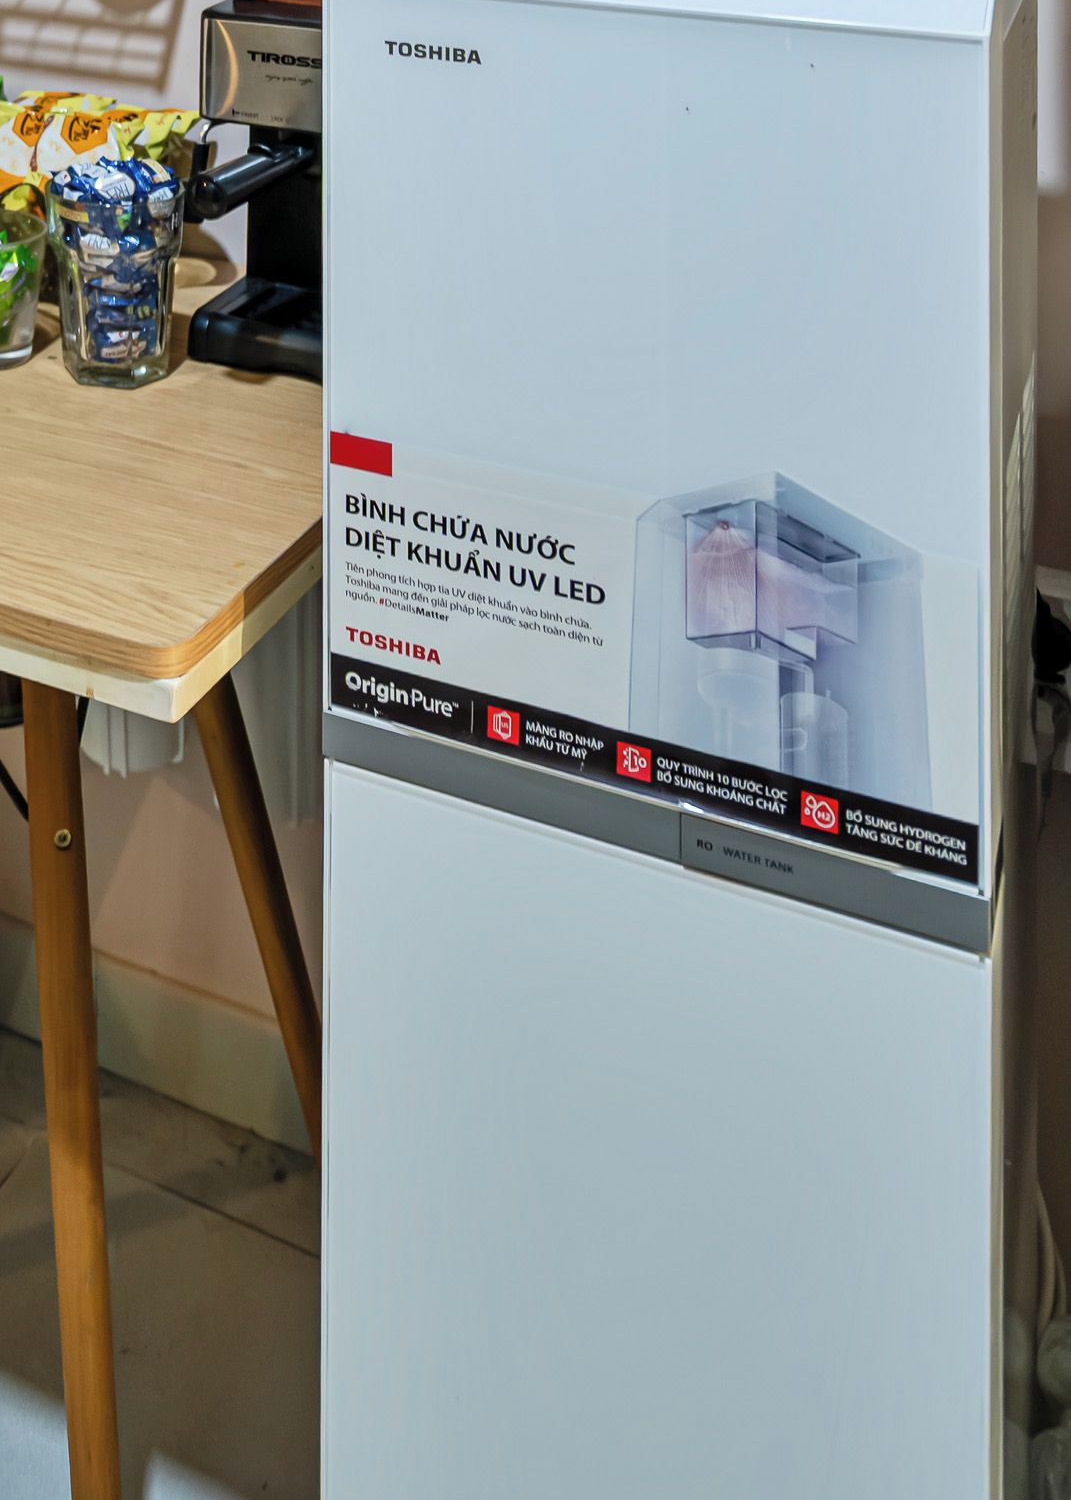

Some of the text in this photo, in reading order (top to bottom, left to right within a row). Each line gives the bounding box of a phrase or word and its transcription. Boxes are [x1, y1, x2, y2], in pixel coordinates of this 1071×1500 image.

[385, 40, 482, 65] TOSHIBA
[346, 493, 576, 566] BÌNH CHỨA NƯỚC
[346, 526, 606, 605] DIỆT KHUẨN UV LED
[346, 575, 381, 592] Toshiba
[382, 584, 409, 600] mang
[367, 566, 397, 584] phong
[452, 587, 466, 599] UV
[346, 626, 441, 665] TOSHIBA
[559, 729, 574, 743] RO
[657, 756, 680, 771] QUY
[717, 773, 730, 786] 10
[674, 776, 705, 793] SUNG
[706, 784, 754, 807] KHOÁNG
[864, 814, 898, 833] SUNG
[899, 823, 967, 851] HYDROGEN
[696, 838, 795, 875] RO WATER TANK
[924, 844, 968, 866] KHÁNG
